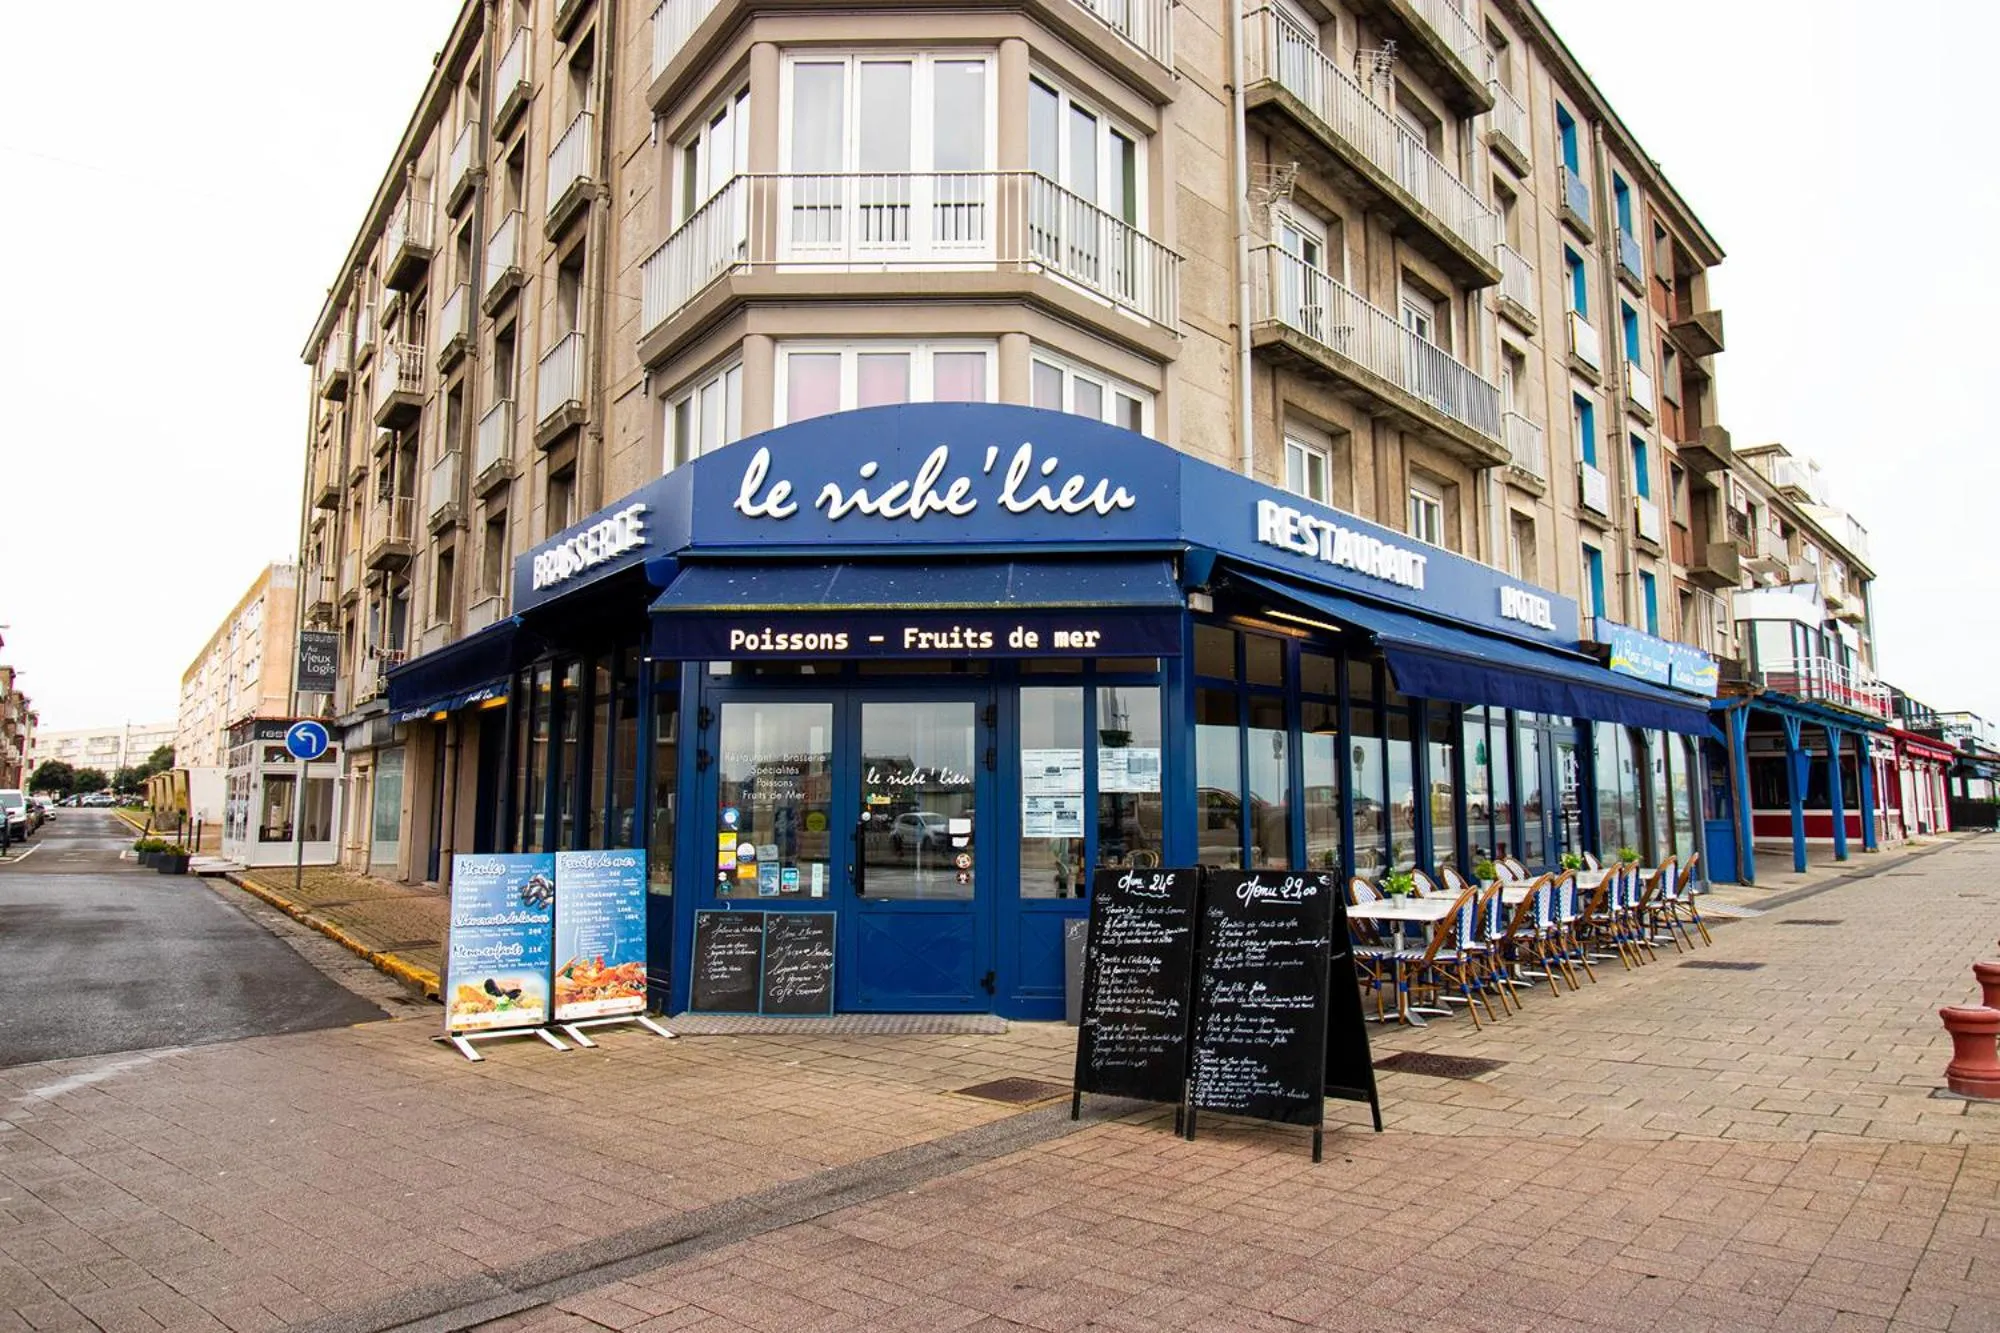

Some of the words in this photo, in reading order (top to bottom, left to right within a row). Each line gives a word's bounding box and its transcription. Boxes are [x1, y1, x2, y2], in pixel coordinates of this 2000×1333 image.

[734, 446, 798, 519] le
[533, 503, 646, 591] BRASSERIE
[1258, 499, 1427, 590] RESTAURANT
[1500, 586, 1557, 631] HOTEL
[730, 629, 848, 650] Poissons
[903, 627, 993, 649] Fruits
[1009, 626, 1039, 648] de
[1054, 629, 1101, 648] mer
[300, 652, 331, 663] Vieux
[307, 663, 336, 675] Logis
[757, 777, 793, 787] Poissons
[866, 766, 880, 785] le
